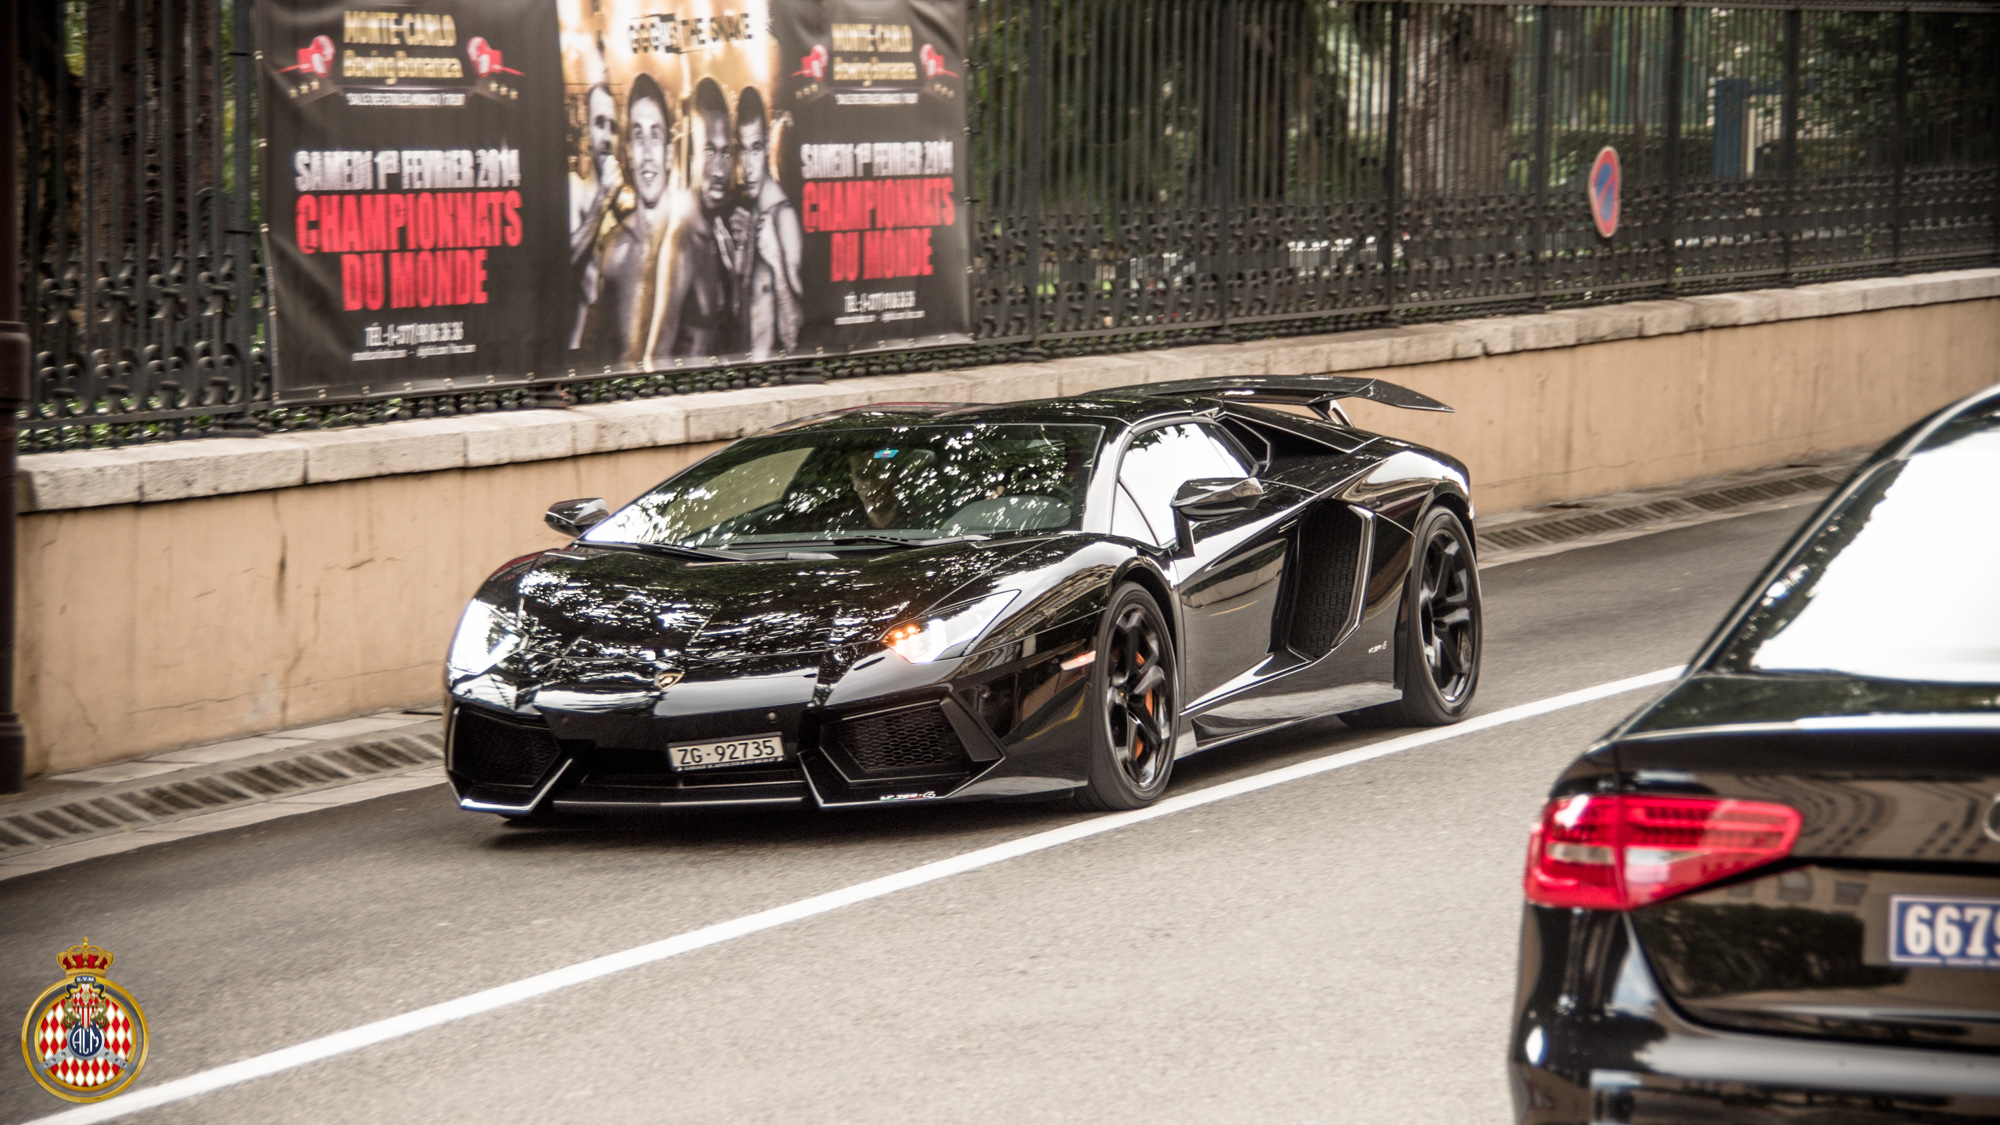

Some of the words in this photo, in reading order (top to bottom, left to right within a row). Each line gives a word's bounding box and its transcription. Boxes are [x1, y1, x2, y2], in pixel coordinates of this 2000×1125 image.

[295, 150, 373, 192] SAMEDI
[475, 148, 521, 188] 2014
[295, 190, 523, 254] CHAMPIONNATS
[802, 177, 956, 234] CHAMPIONNATS
[341, 253, 385, 312] DU
[389, 249, 489, 309] MONDE
[830, 231, 860, 283] DU
[862, 228, 934, 281] MONDE
[1904, 904, 2000, 957] 667
